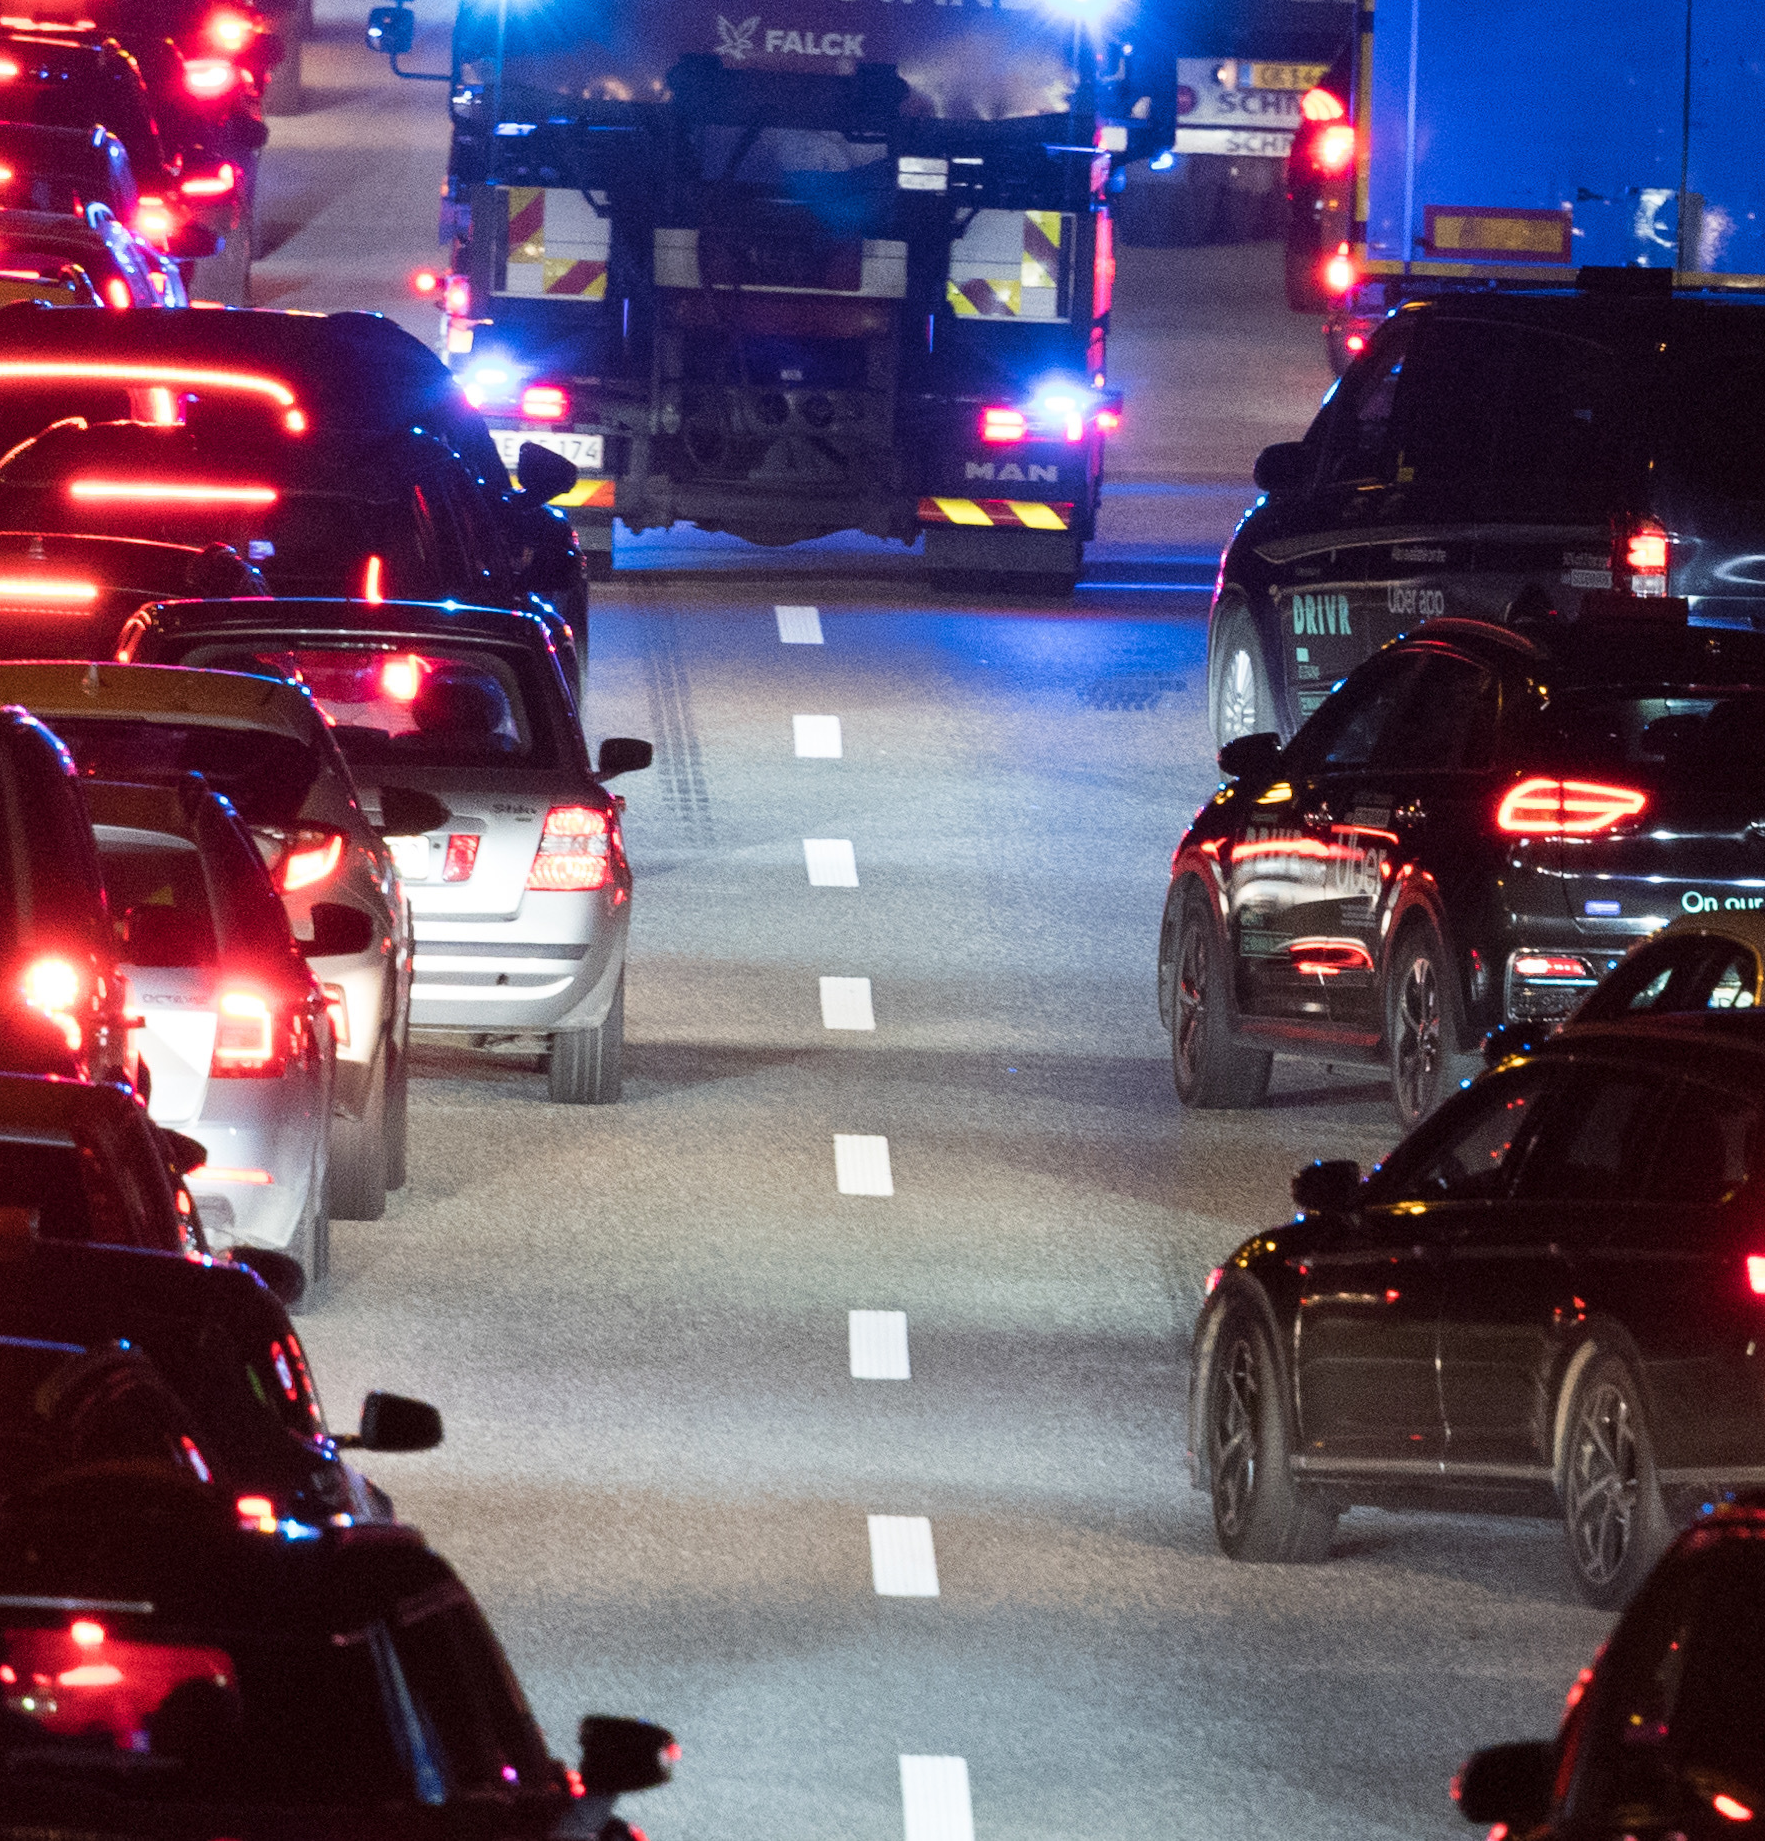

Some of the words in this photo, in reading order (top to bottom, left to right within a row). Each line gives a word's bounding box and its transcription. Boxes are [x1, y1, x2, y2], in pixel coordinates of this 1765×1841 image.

[765, 29, 866, 56] FALCK
[965, 461, 1058, 483] MAN
[1292, 594, 1352, 636] DRIVR
[1682, 890, 1719, 914] On
